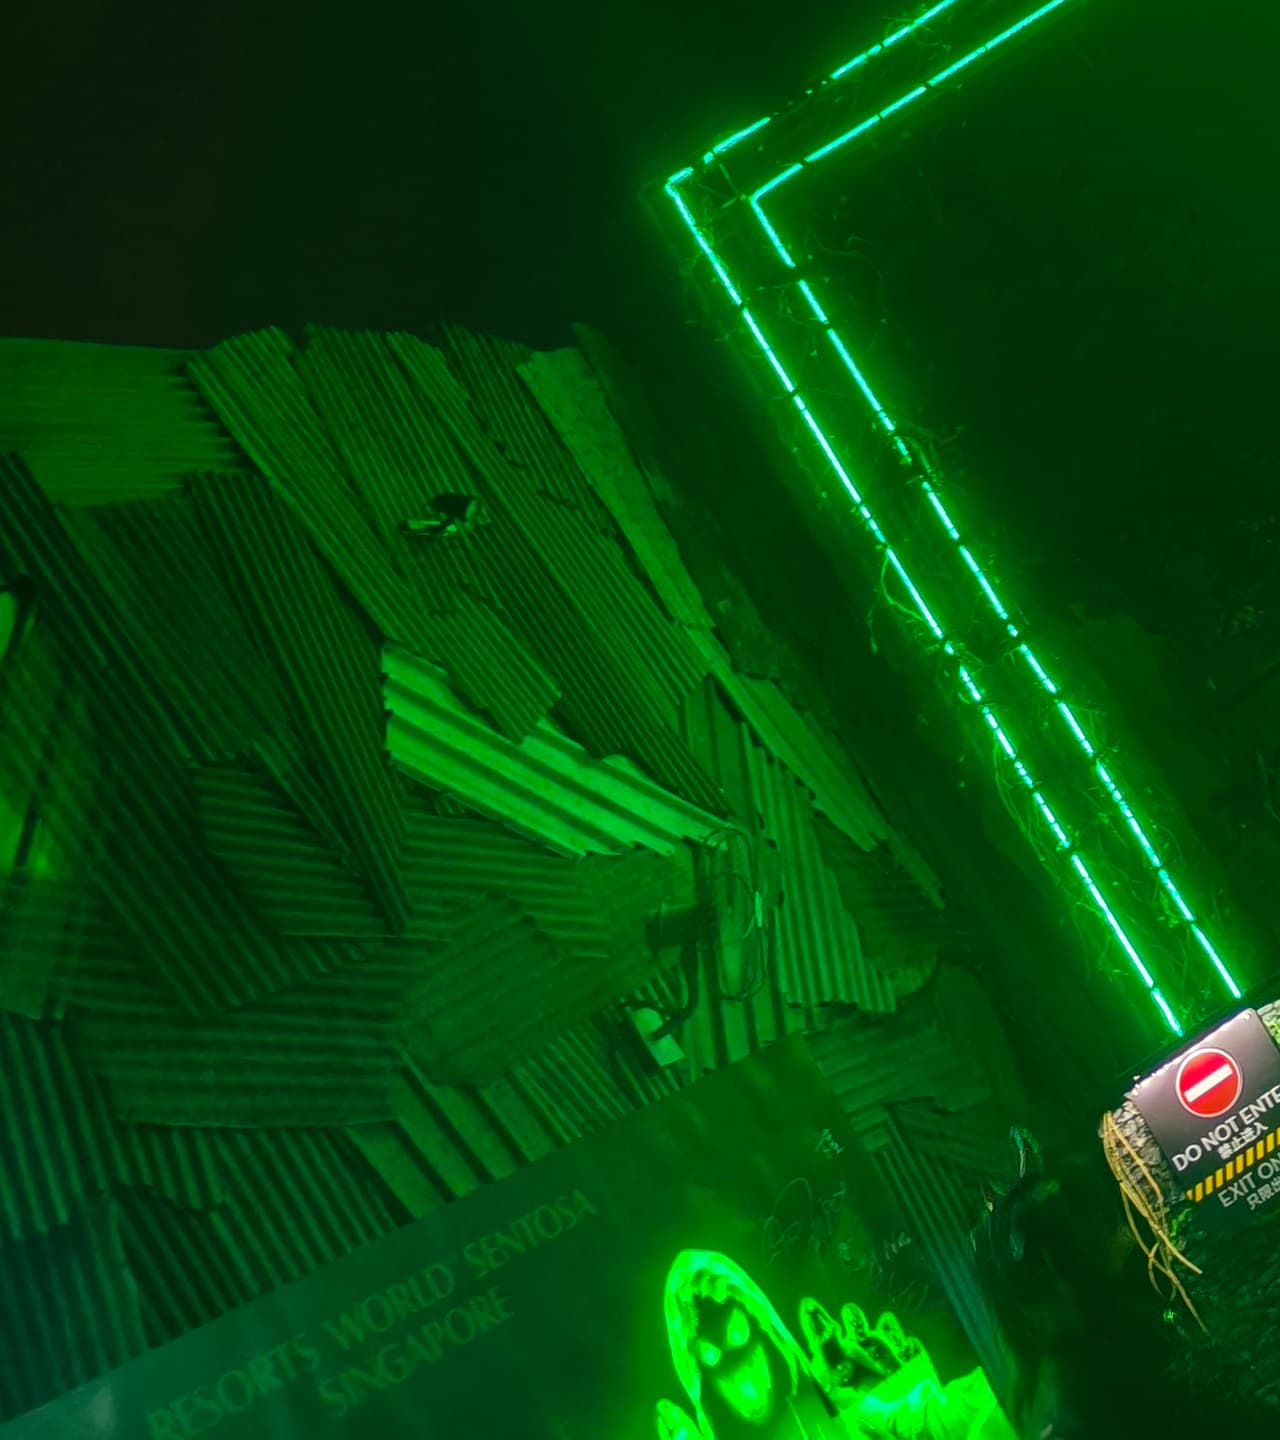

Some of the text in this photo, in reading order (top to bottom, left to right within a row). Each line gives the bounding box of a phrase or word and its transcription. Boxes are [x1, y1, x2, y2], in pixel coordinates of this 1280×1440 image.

[1172, 1144, 1202, 1172] DO
[1200, 1115, 1239, 1152] NOT
[1218, 1171, 1256, 1208] EXIT
[146, 1190, 597, 1440] RESORTS WORLD SENTOSA
[318, 1287, 514, 1417] SINGAPORE
